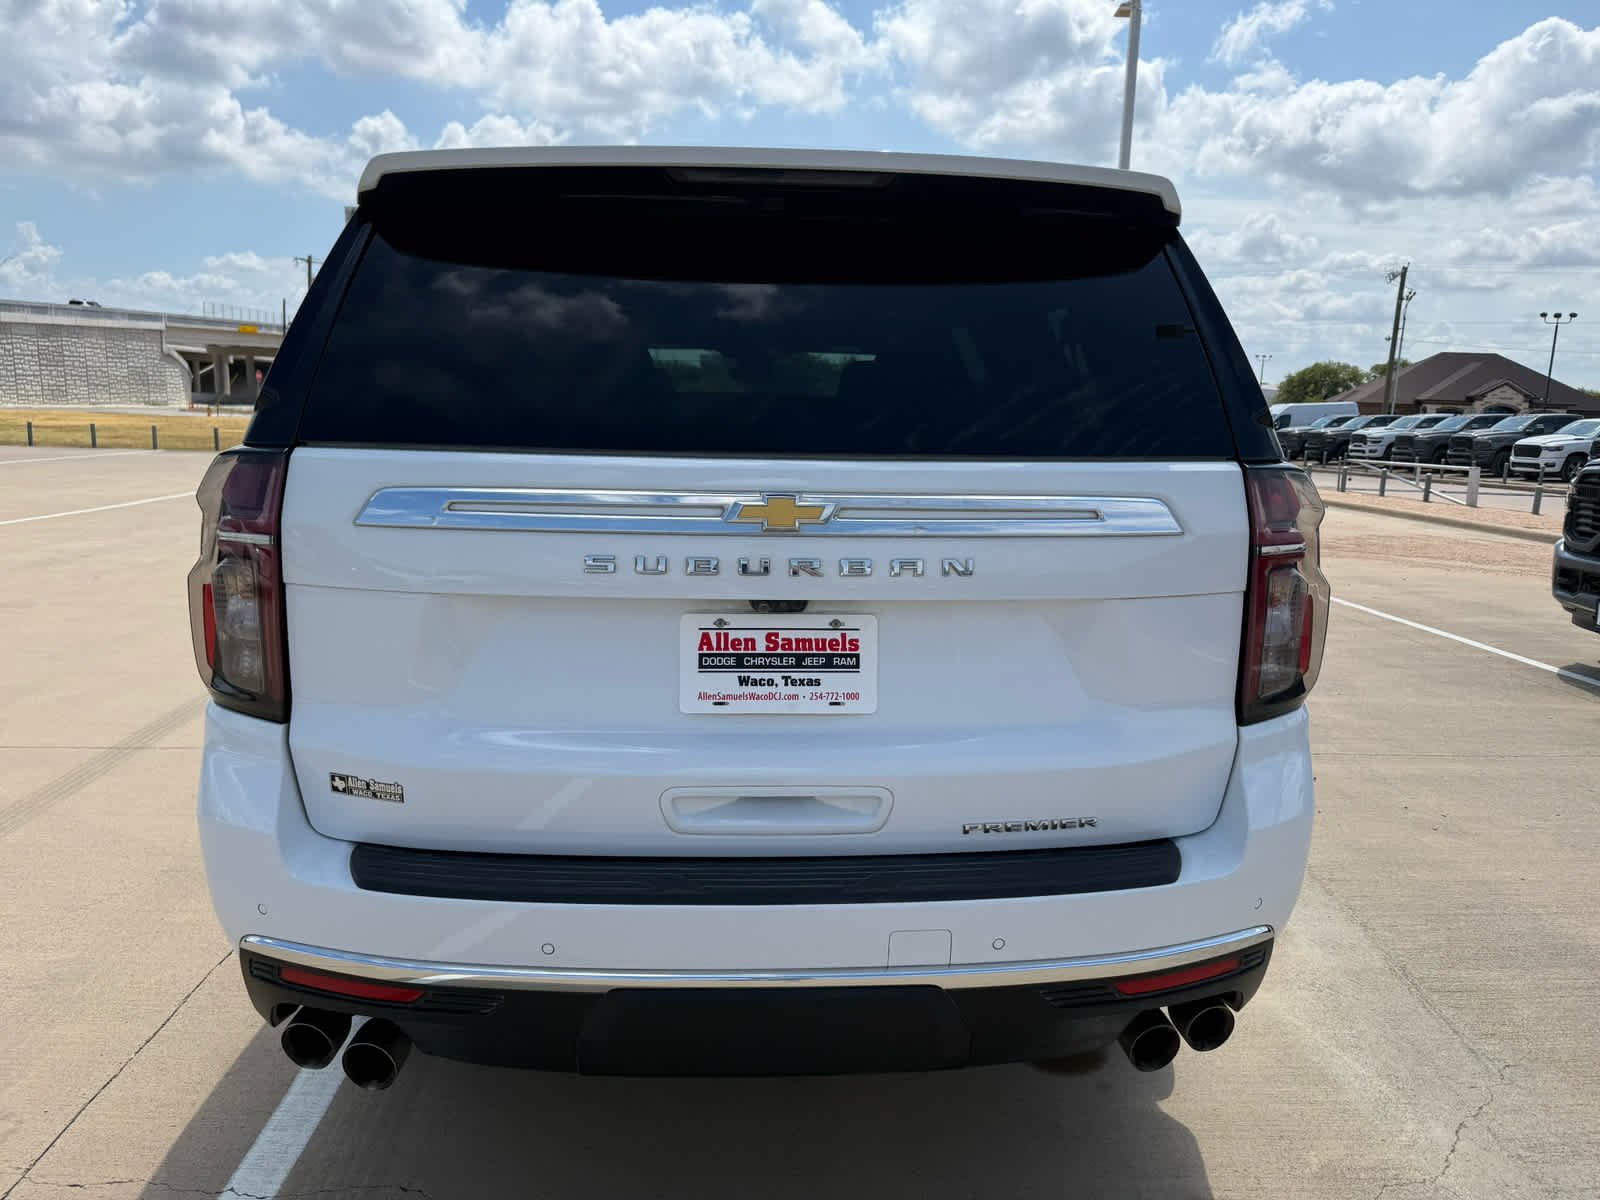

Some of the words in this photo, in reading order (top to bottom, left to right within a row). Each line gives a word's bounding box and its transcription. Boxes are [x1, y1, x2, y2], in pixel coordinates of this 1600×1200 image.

[584, 555, 976, 577] SUBURBAN
[698, 632, 756, 652] Allen
[765, 632, 860, 652] Samuels
[702, 657, 737, 666] DODGE
[743, 657, 796, 666] CHRYSLER
[802, 657, 826, 666] JEEP
[833, 657, 856, 666] RAM
[737, 676, 779, 688] Waco,
[782, 676, 821, 687] Texas
[697, 692, 799, 701] AllenSamuelsWacoDCJ.com
[809, 692, 860, 701] 254-772-1000
[348, 777, 367, 790] Allen
[369, 779, 402, 794] Samuels
[962, 817, 1098, 834] PREMIER
